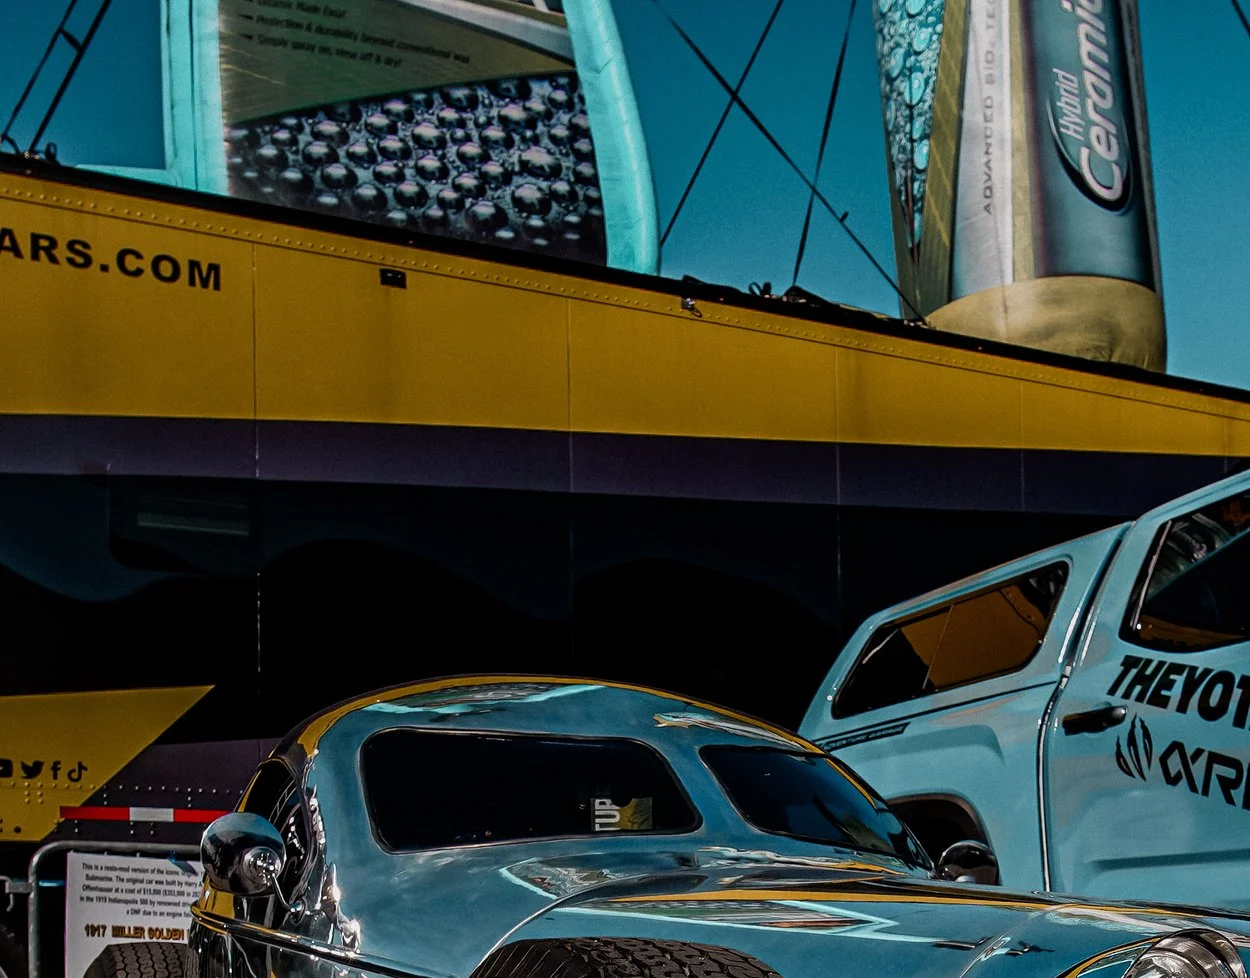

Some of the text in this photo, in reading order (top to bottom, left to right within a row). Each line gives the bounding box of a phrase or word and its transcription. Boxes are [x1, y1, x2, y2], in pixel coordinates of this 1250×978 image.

[1052, 67, 1086, 141] Hybrid
[983, 95, 994, 216] ADVANCED
[0, 227, 222, 291] ARS.COM
[82, 862, 93, 871] This
[116, 875, 124, 883] The
